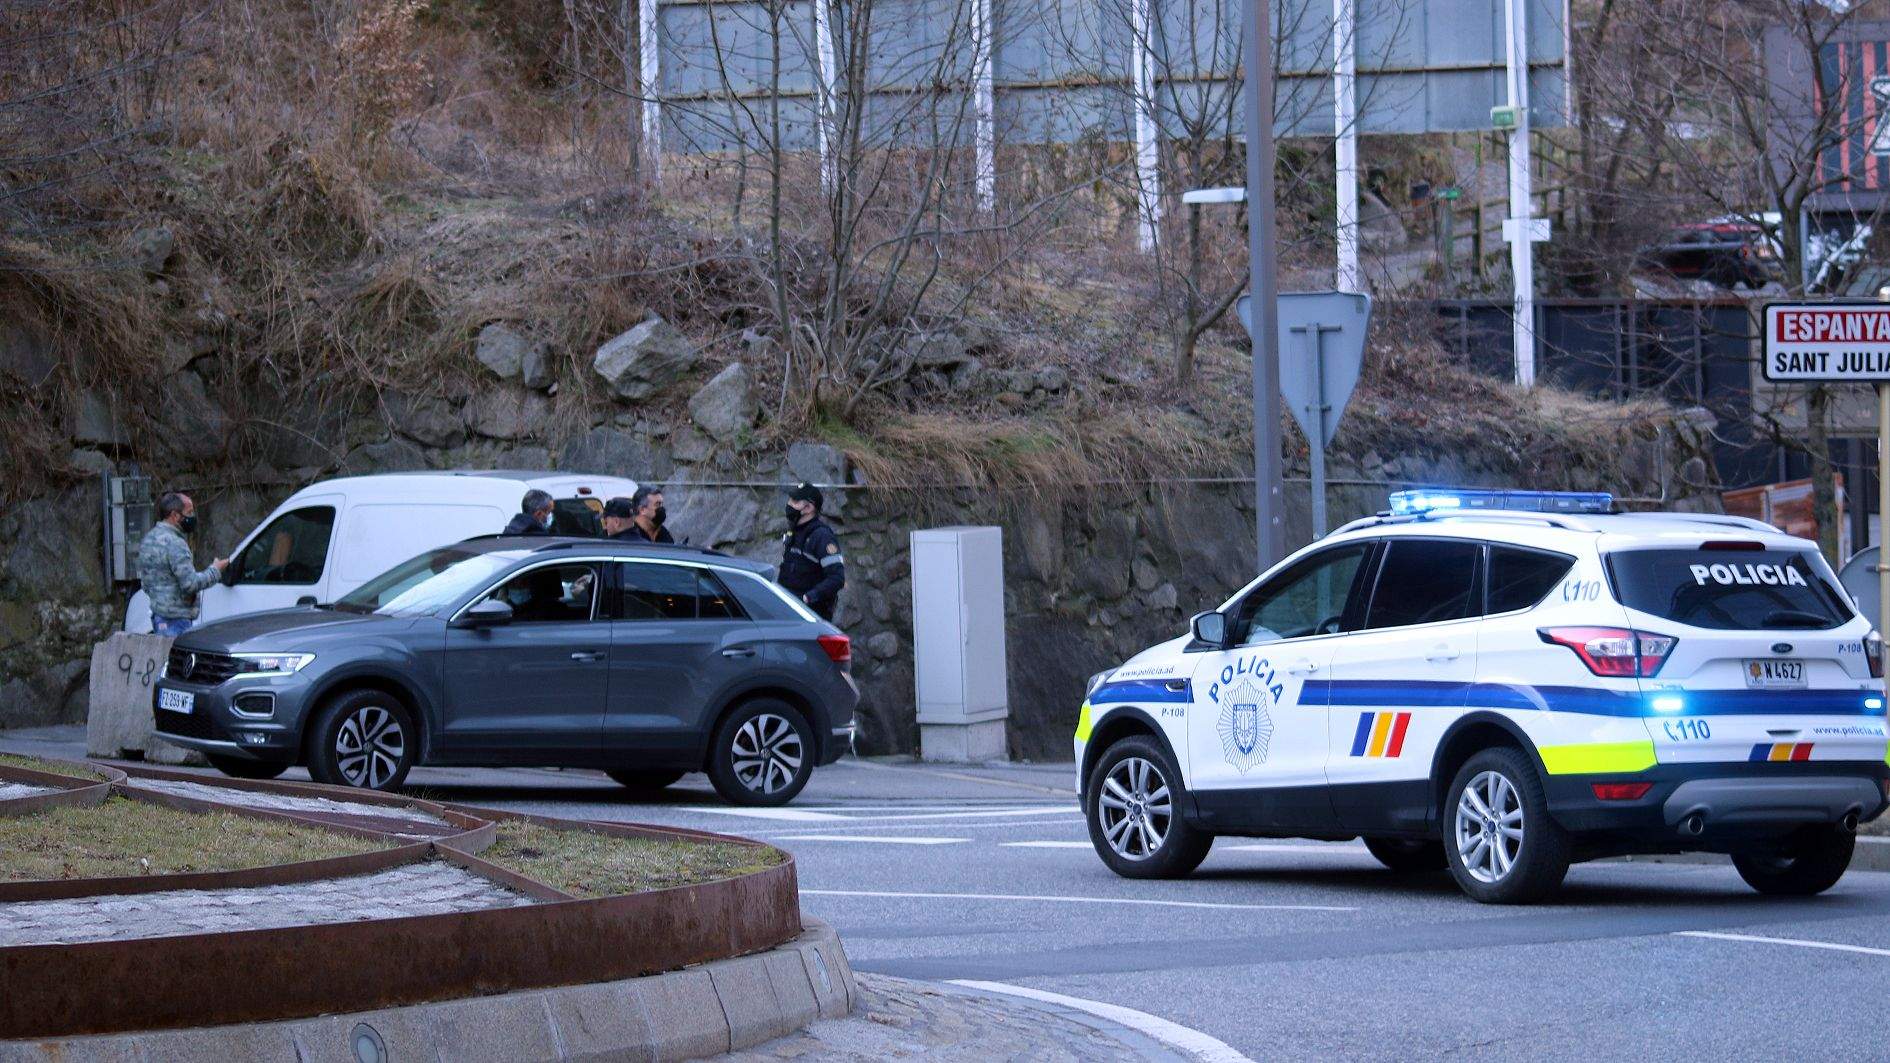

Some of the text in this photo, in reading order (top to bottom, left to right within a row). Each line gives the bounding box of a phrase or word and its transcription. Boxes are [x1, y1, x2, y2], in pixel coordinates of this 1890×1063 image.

[1783, 312, 1890, 341] ESPANYA
[1775, 352, 1830, 373] SANT
[1689, 563, 1808, 588] POLICIA
[1573, 580, 1600, 601] 110
[1838, 643, 1861, 653] P-108
[118, 653, 155, 687] 9-8
[1120, 665, 1175, 678] www.policia.ad
[1208, 655, 1284, 705] POLICIA
[1161, 707, 1185, 717] P-108
[1676, 719, 1711, 740] 110
[1813, 726, 1885, 737] www.policia.ad
